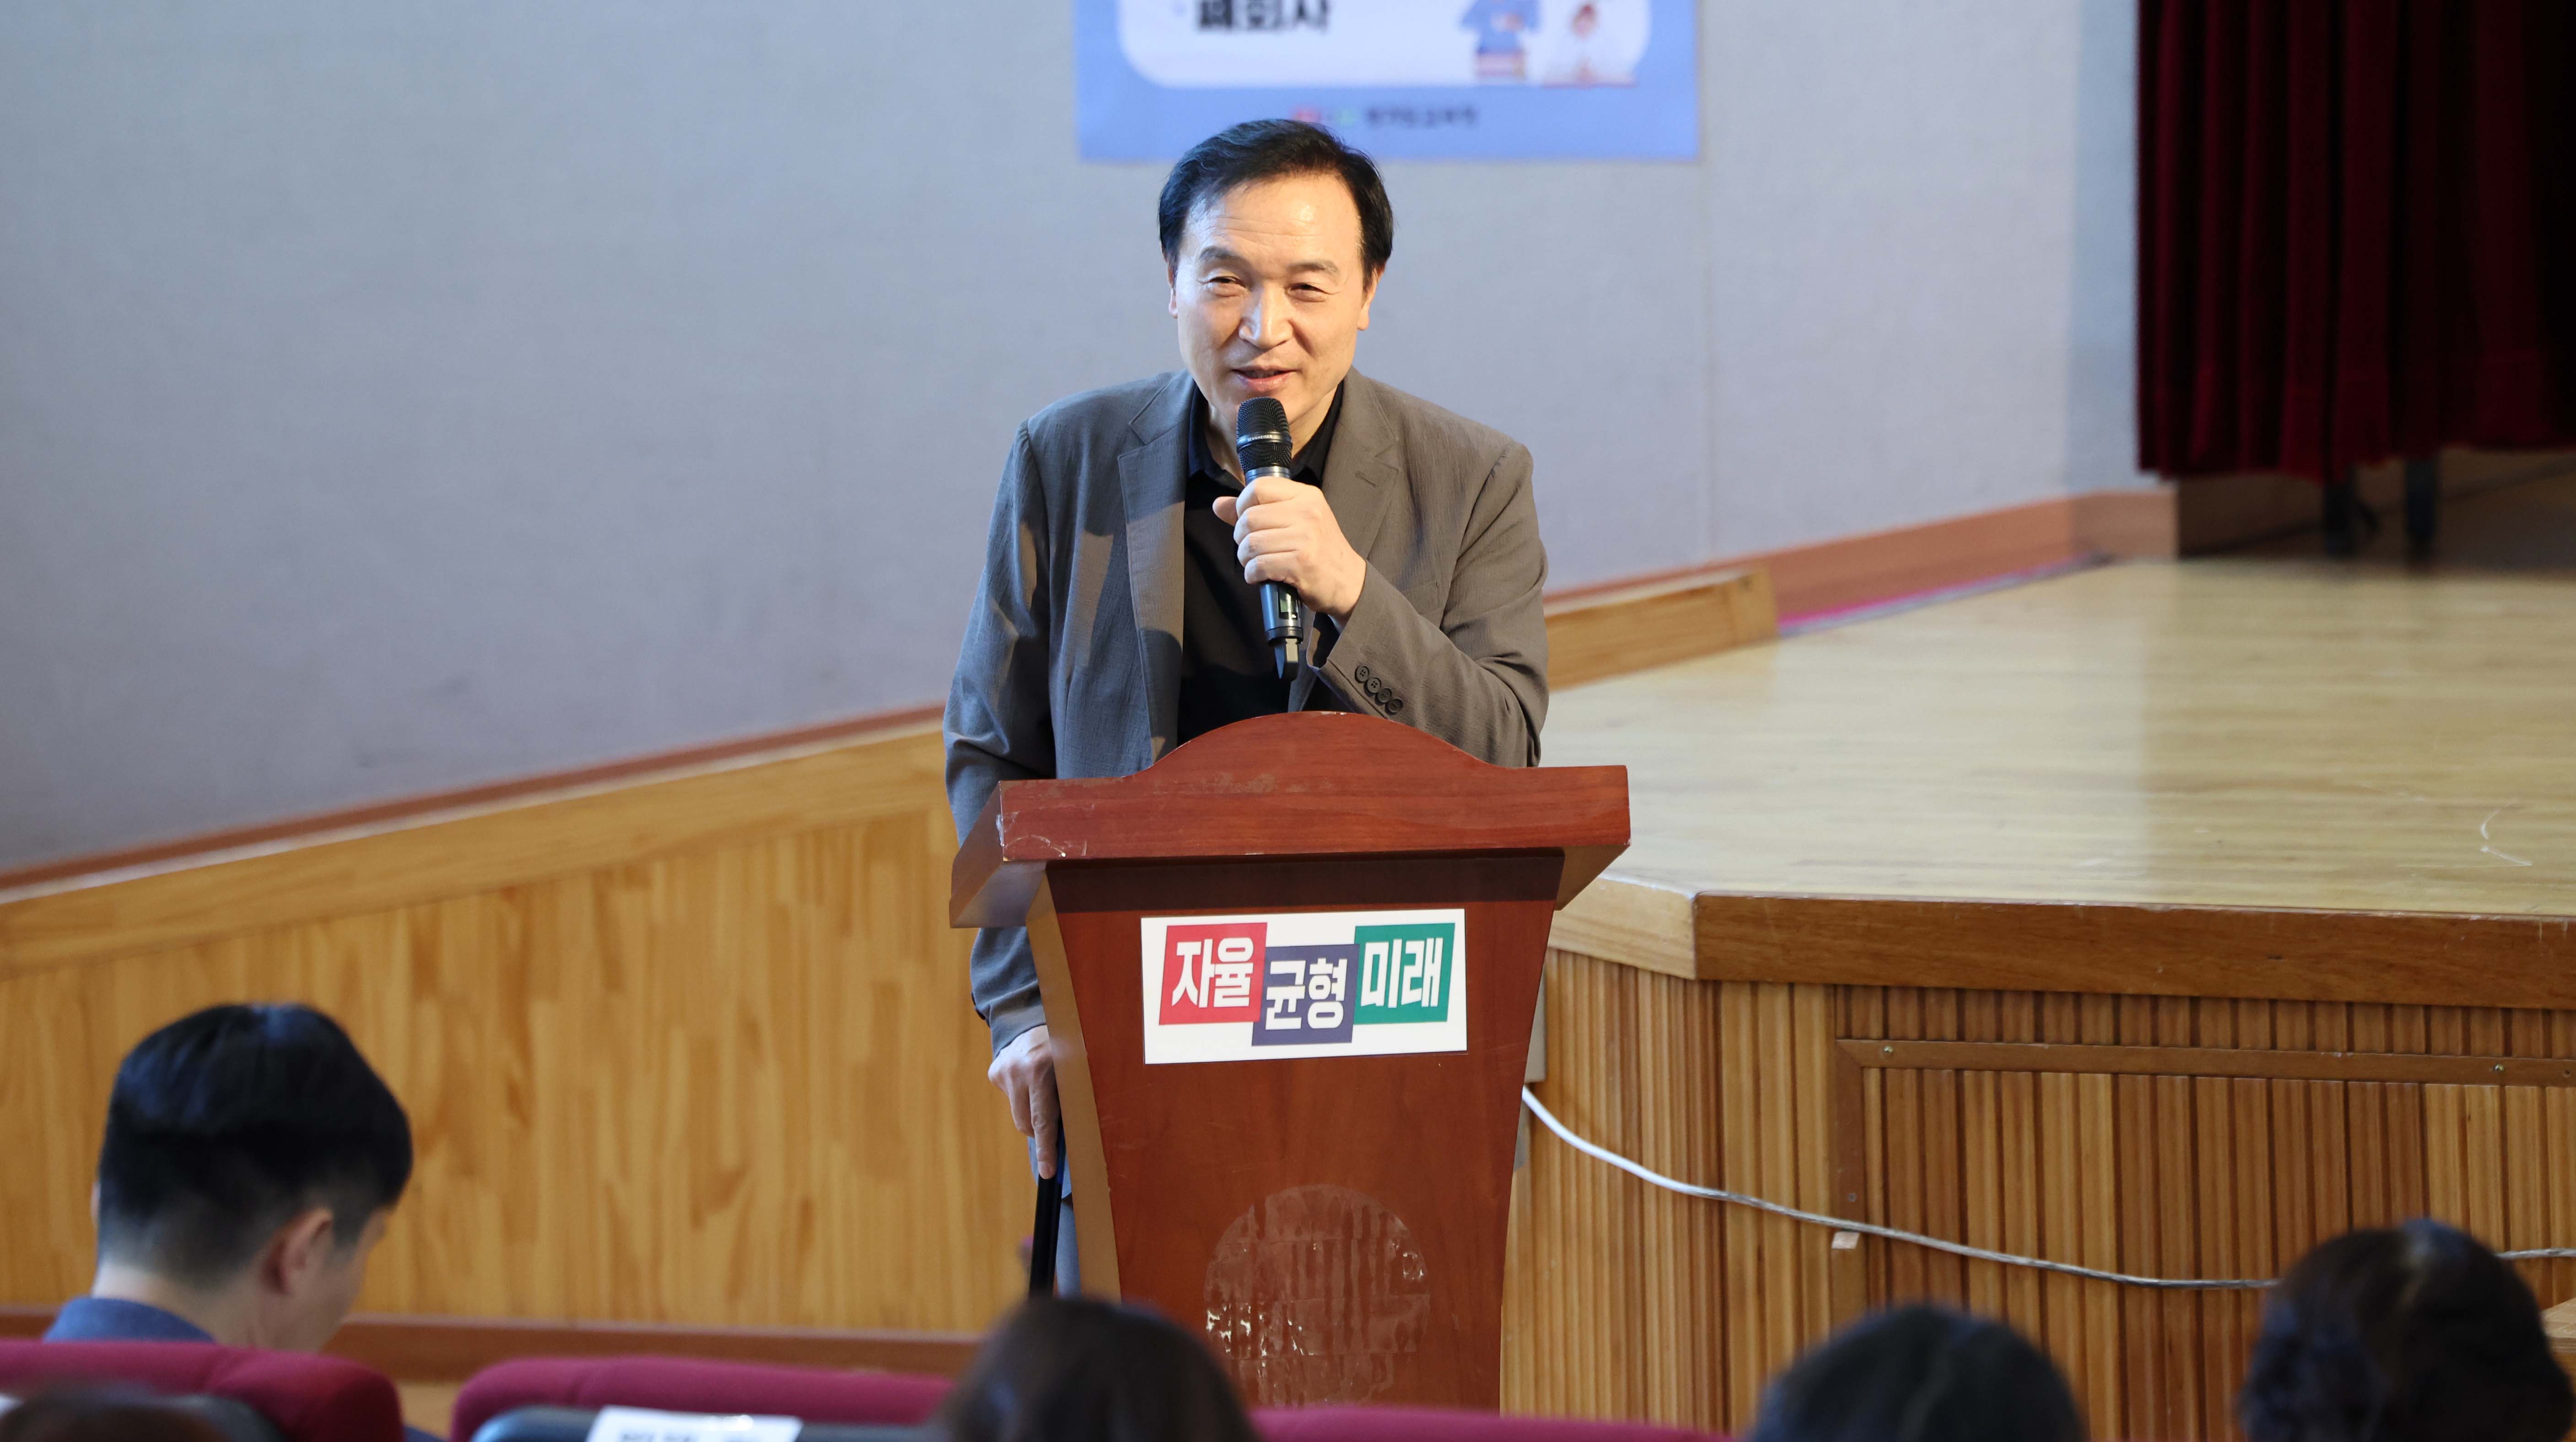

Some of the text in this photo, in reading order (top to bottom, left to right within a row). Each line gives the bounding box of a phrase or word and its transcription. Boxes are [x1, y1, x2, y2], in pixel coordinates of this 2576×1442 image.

[1172, 937, 1444, 1030] 자율 균형 미래
